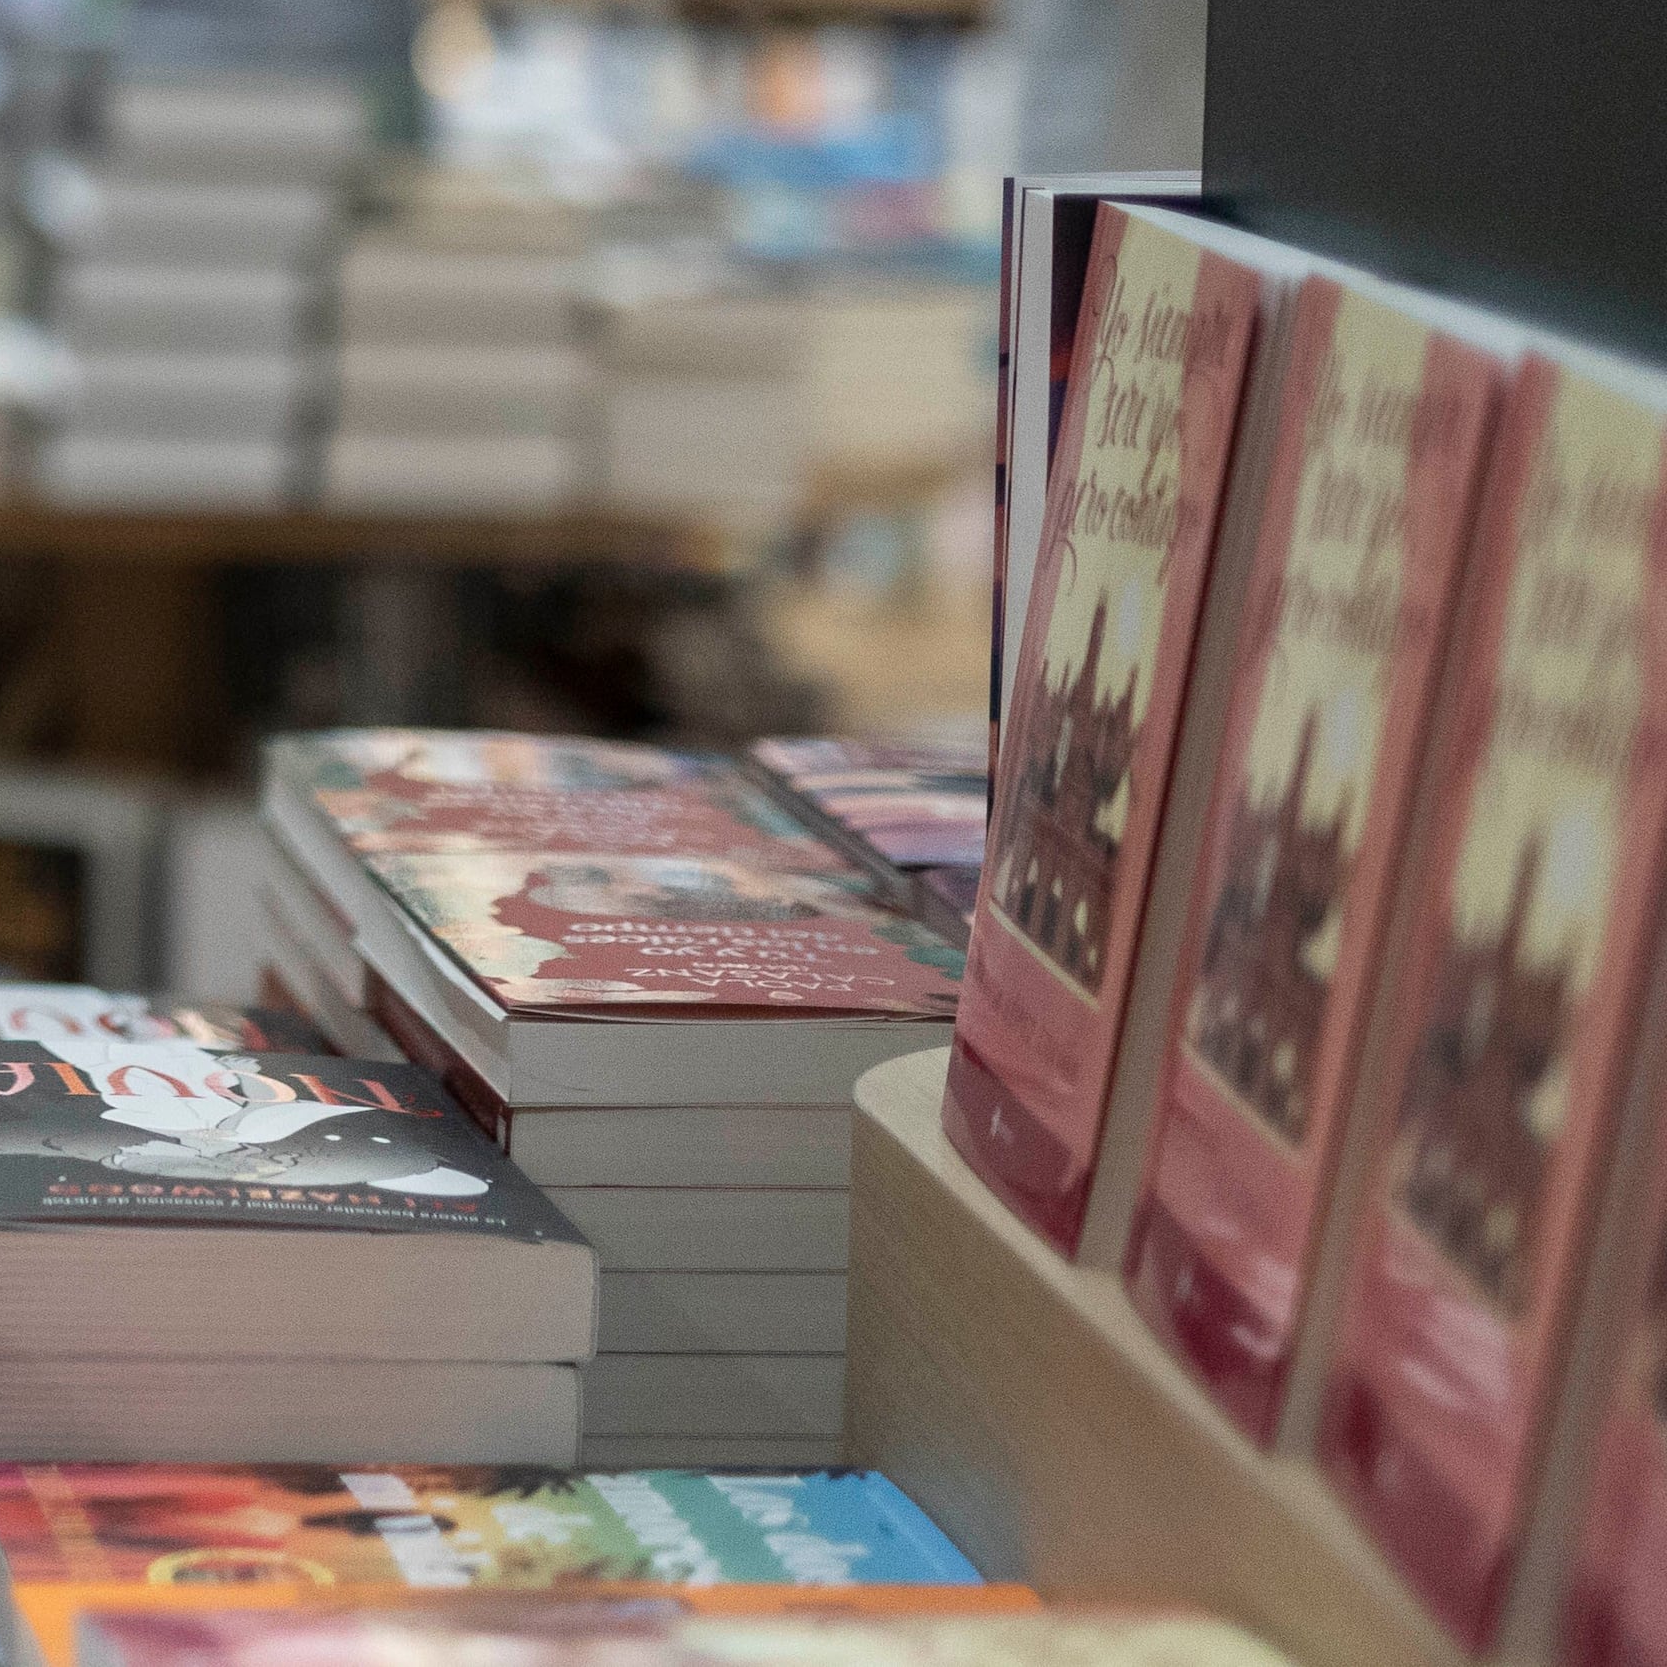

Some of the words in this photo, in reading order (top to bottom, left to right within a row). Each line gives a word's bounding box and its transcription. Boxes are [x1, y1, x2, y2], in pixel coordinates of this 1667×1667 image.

[567, 921, 757, 937] tiempo
[637, 945, 703, 958] yo
[622, 966, 898, 987] CALASANZ
[692, 977, 854, 992] PAOLA
[45, 1182, 381, 1205] HAZELWOOD
[244, 1200, 322, 1212] mundial
